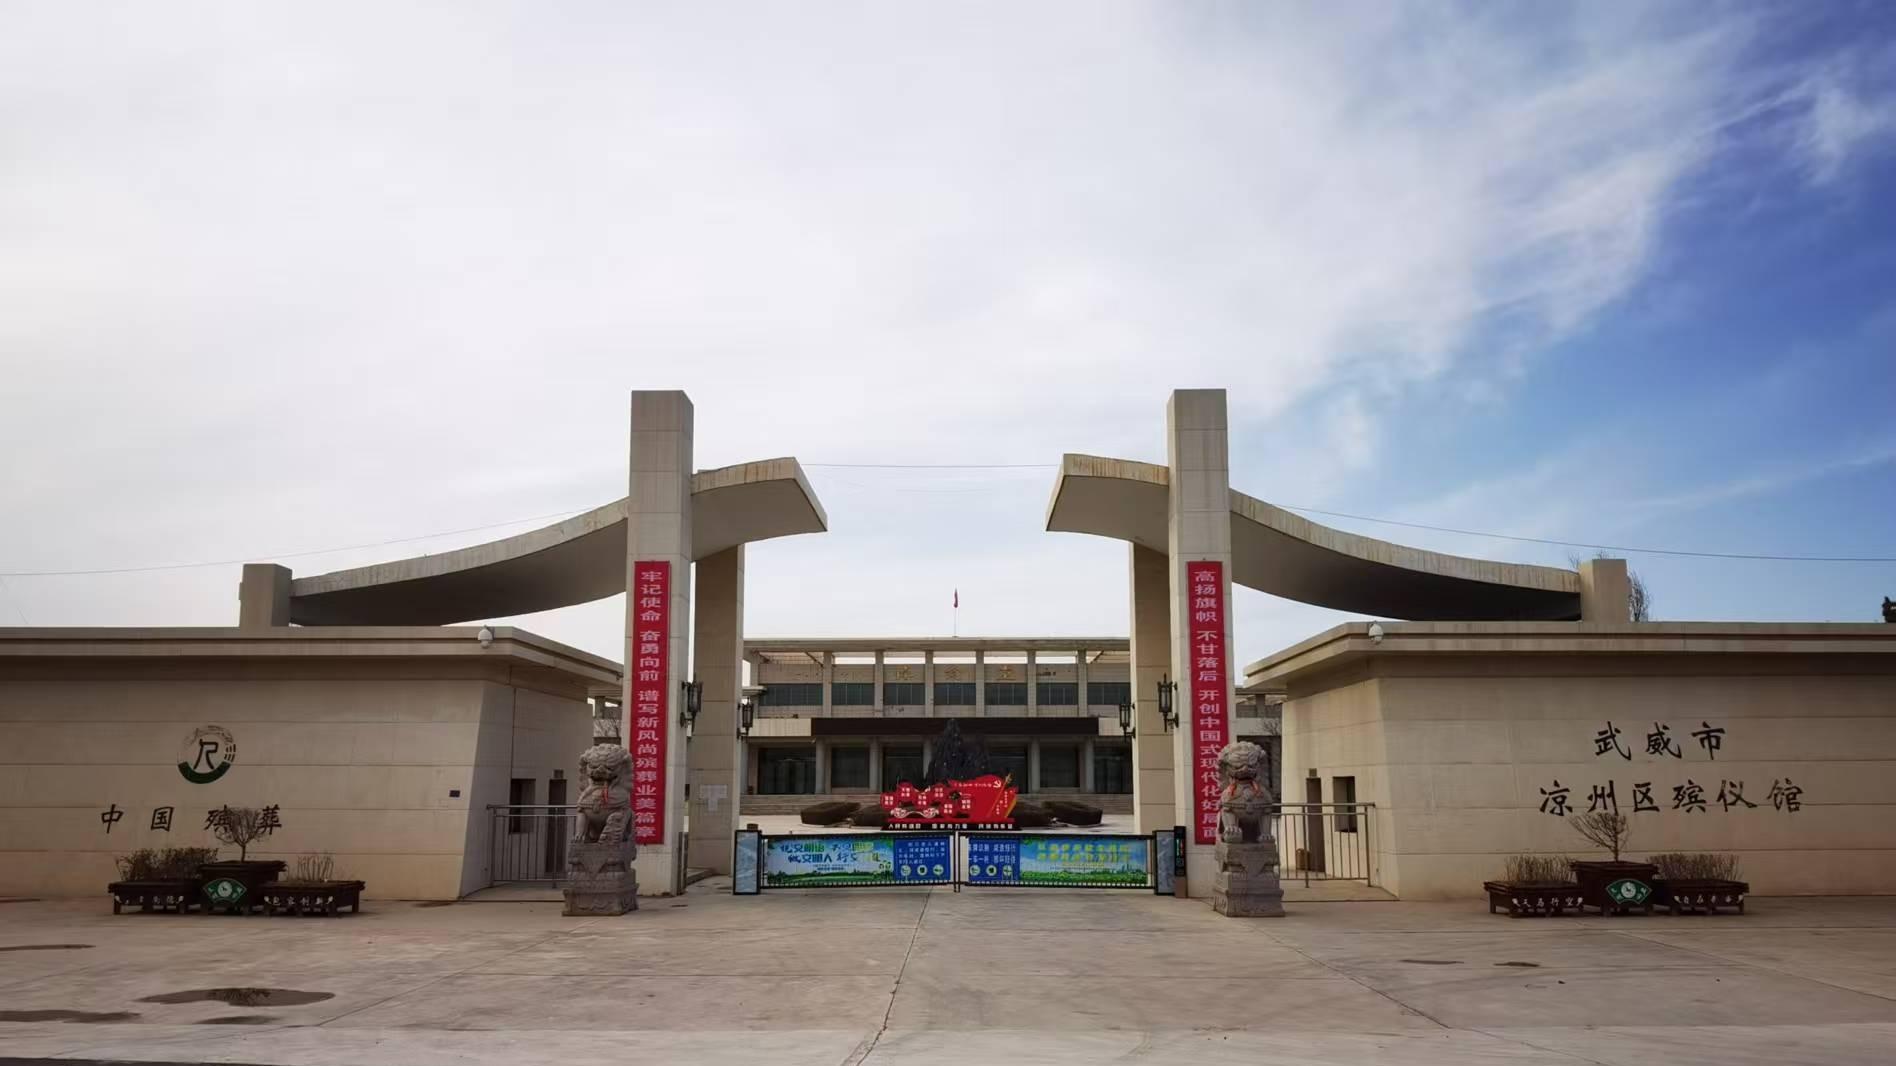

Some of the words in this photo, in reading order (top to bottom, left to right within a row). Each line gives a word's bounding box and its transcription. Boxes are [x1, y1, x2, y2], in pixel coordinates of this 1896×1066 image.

[640, 570, 663, 622] 牢记使命
[1194, 570, 1217, 622] 高扬旗帜
[638, 630, 661, 682] 奋勇向前
[1196, 630, 1219, 682] 不甘落后
[1594, 721, 1726, 761] 武威市
[101, 804, 283, 835] 中国殡葬
[1539, 778, 1805, 817] 凉州区殡仪馆
